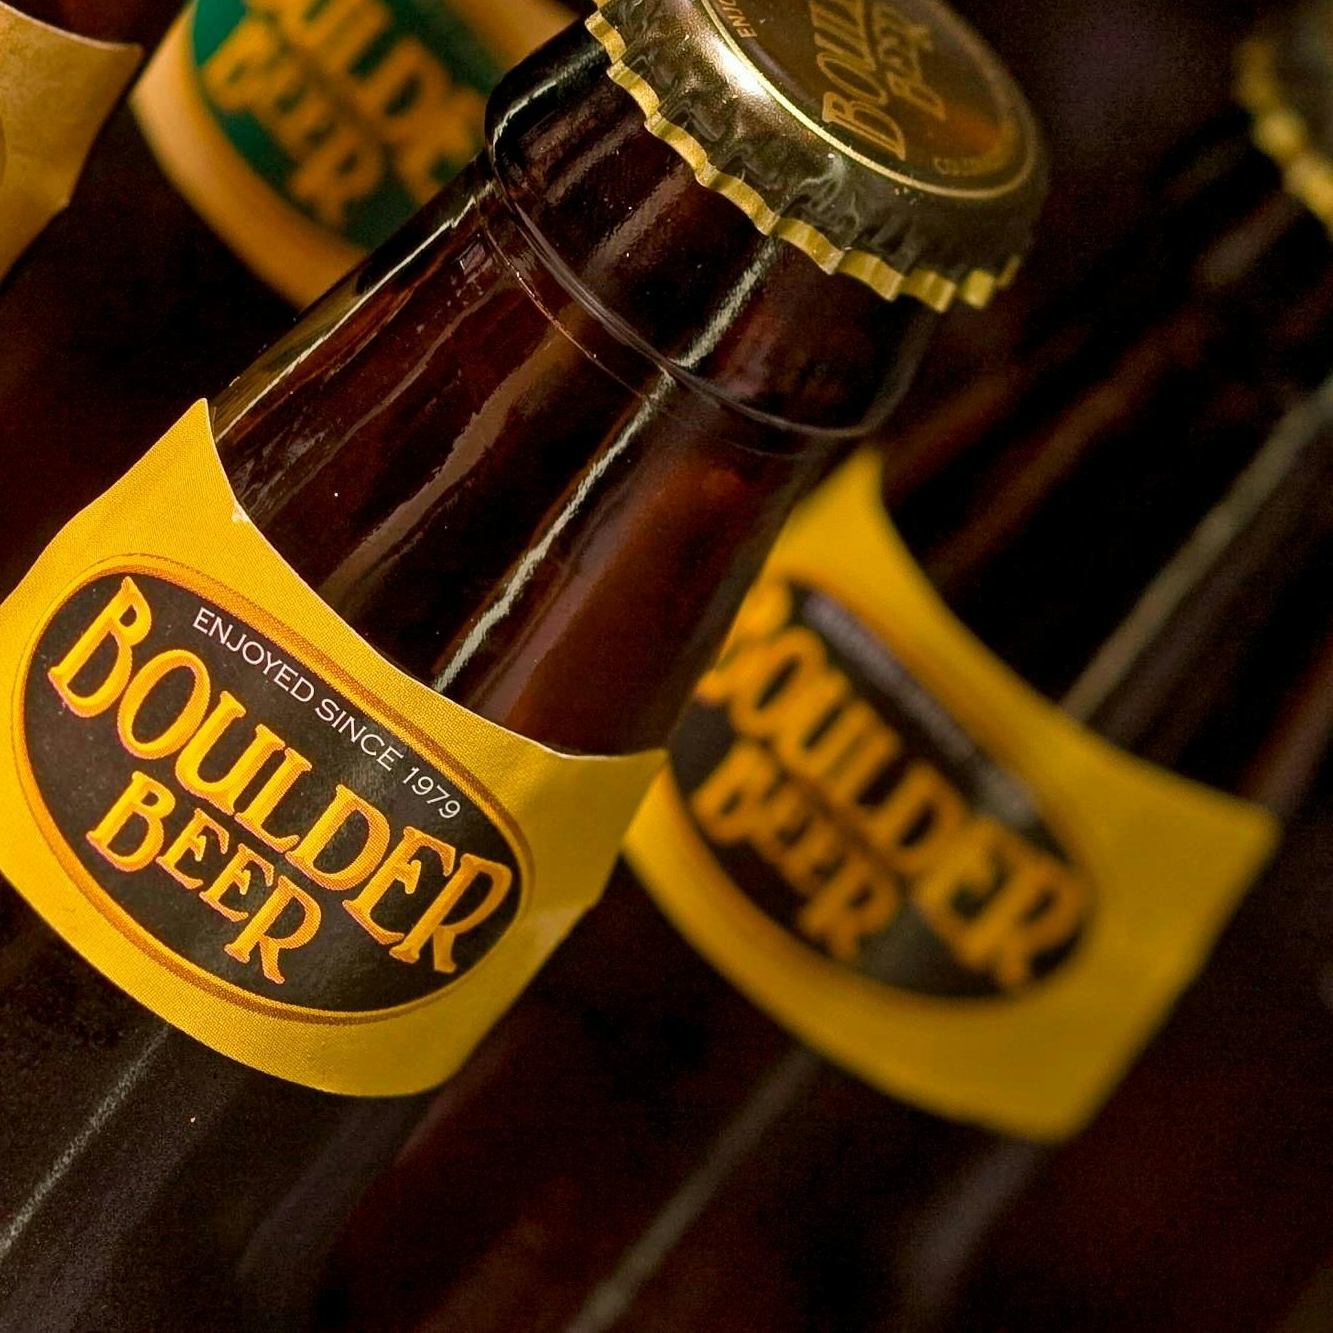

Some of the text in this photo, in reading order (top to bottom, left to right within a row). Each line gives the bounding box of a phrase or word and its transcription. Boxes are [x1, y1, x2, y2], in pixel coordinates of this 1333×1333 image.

[47, 575, 513, 976] BOULDER
[191, 605, 462, 821] ENJOYED SINCE 1979
[85, 769, 323, 986] BEER
